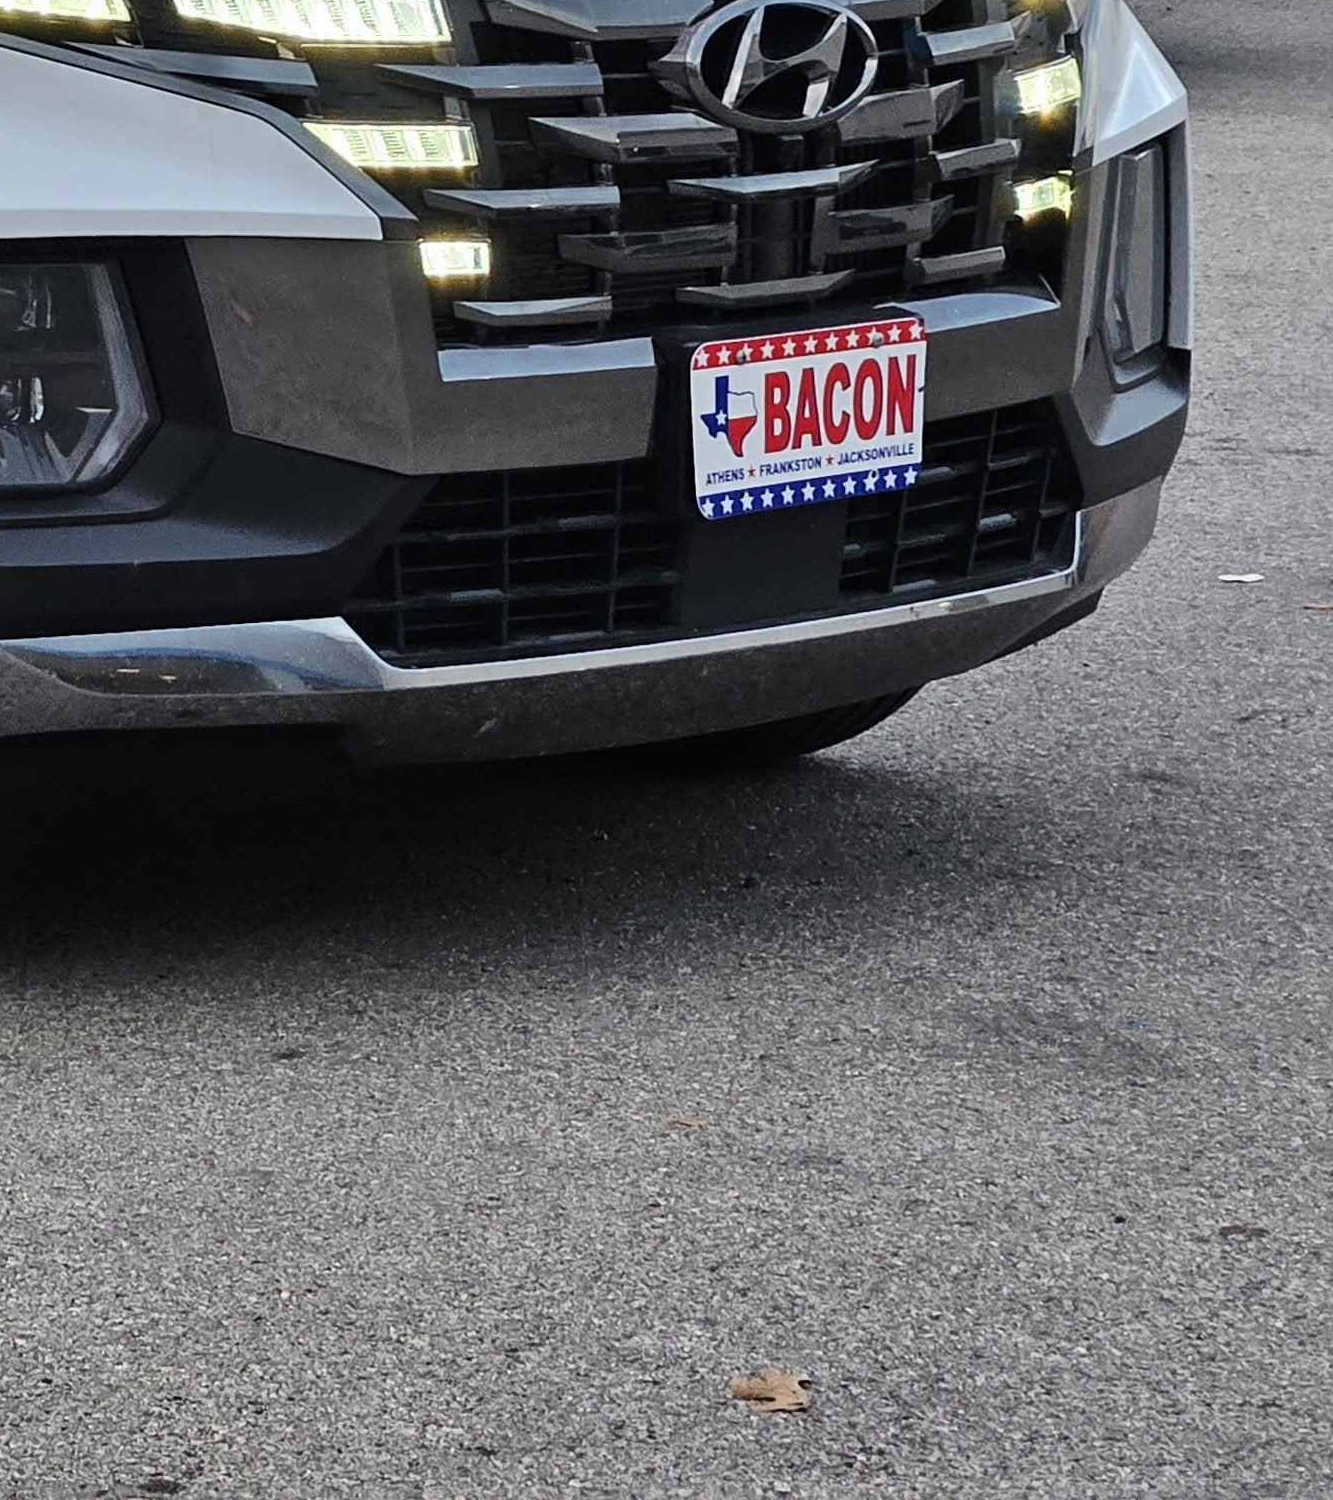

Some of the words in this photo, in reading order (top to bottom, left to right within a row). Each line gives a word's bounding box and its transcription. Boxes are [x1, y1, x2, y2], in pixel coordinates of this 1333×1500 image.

[764, 354, 917, 454] BACON
[705, 467, 745, 486] ATHENS
[759, 455, 823, 476] FRANKSTON
[837, 442, 915, 466] JACKSONVILLE
